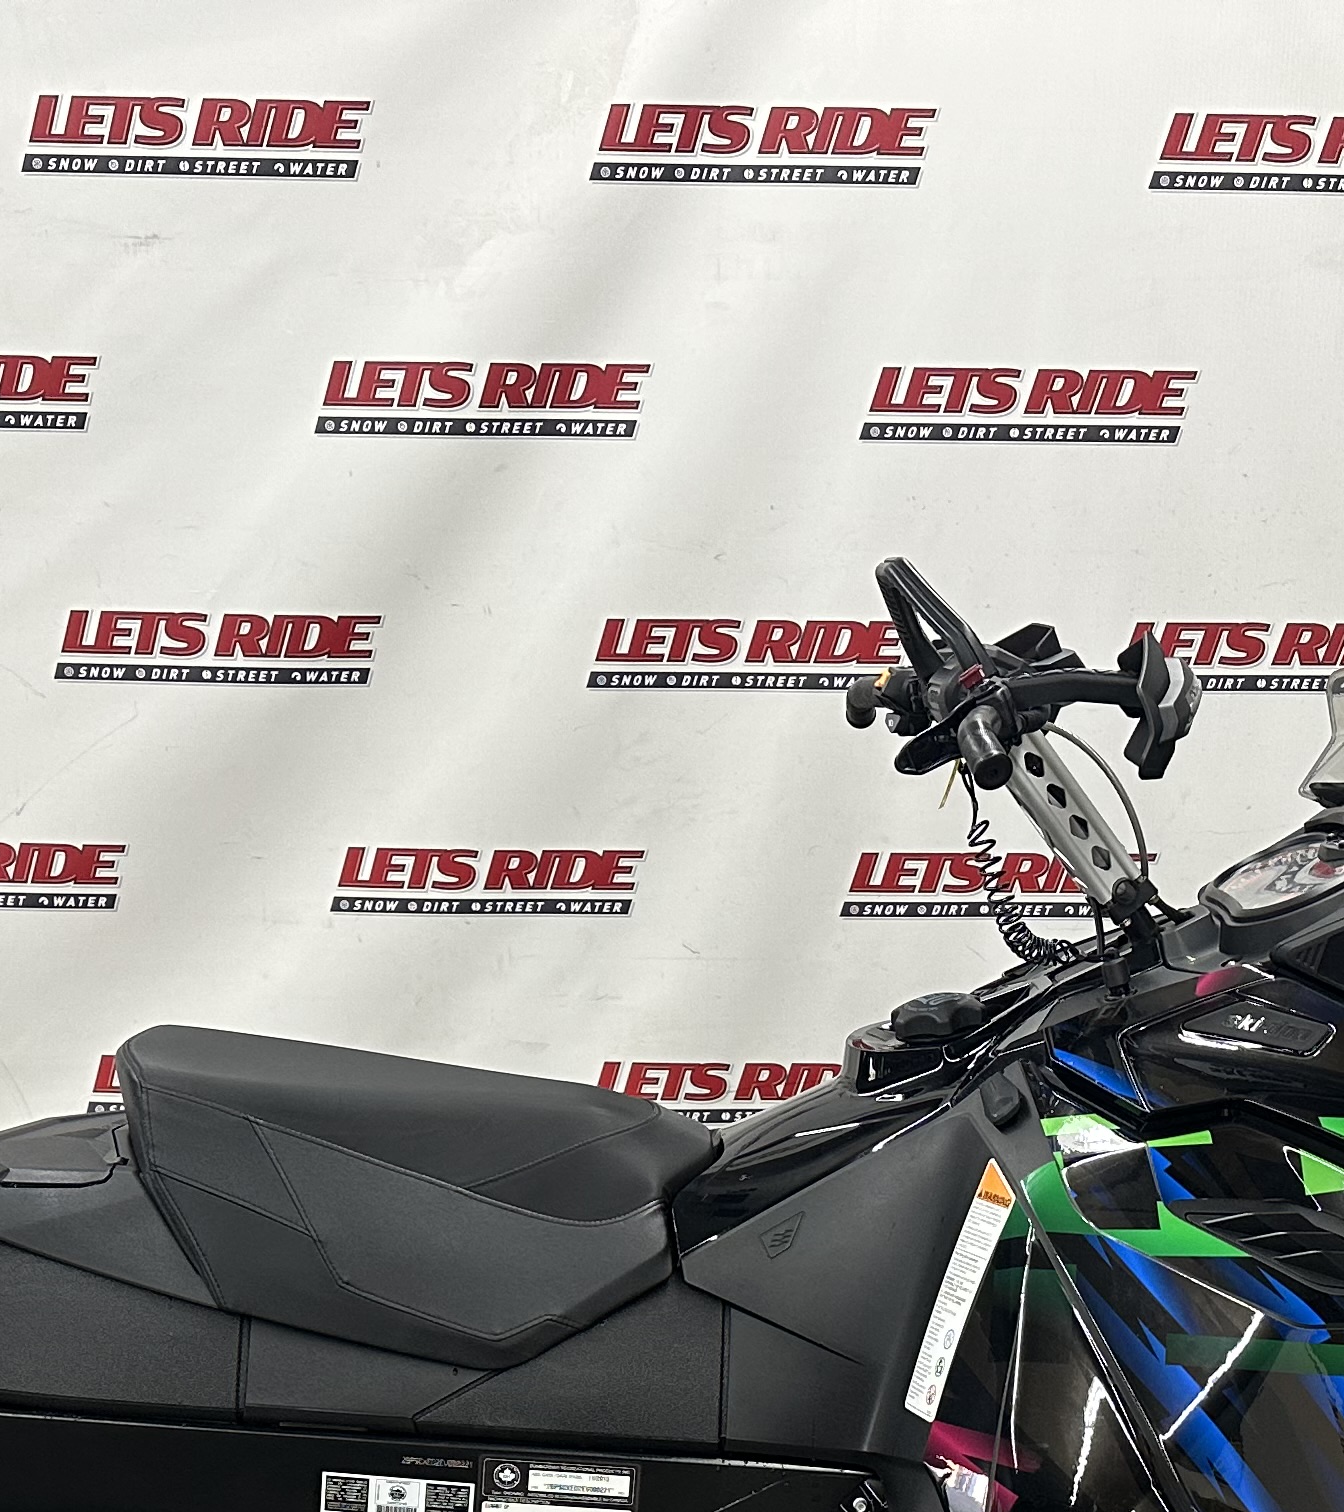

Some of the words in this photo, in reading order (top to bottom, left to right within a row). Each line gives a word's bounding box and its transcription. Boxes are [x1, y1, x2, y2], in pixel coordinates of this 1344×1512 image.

[29, 95, 185, 145] LETS
[192, 99, 370, 149] RIDE
[599, 104, 753, 154] LETS
[758, 107, 936, 156] RIDE
[1160, 113, 1316, 163] LETS
[47, 157, 99, 172] SNOW
[124, 159, 167, 173] DIRT
[192, 160, 261, 175] STREET
[289, 161, 348, 176] WATER
[614, 165, 665, 180] SNOW
[689, 167, 732, 181] DIRT
[757, 168, 825, 182] STREET
[852, 169, 910, 183] WATER
[1173, 174, 1225, 188] SNOW
[1248, 175, 1291, 190] DIRT
[323, 361, 471, 408] LETS
[479, 363, 650, 409] RIDE
[869, 367, 1021, 414] LETS
[1024, 369, 1197, 415] RIDE
[20, 413, 77, 427] WATER
[338, 419, 388, 433] SNOW
[412, 420, 454, 434] DIRT
[479, 421, 544, 434] STREET
[570, 422, 627, 435] WATER
[883, 425, 934, 439] SNOW
[957, 426, 998, 439] DIRT
[1022, 427, 1088, 440] STREET
[1114, 428, 1170, 441] WATER
[62, 610, 207, 656] LETS
[214, 614, 381, 658] RIDE
[594, 618, 741, 662] LETS
[744, 620, 902, 664] RIDE
[77, 666, 127, 679] SNOW
[150, 667, 191, 681] DIRT
[215, 669, 279, 682] STREET
[306, 670, 361, 683] WATER
[339, 847, 478, 890] LETS
[484, 850, 644, 890] RIDE
[849, 852, 990, 893] LETS
[53, 895, 108, 907] WATER
